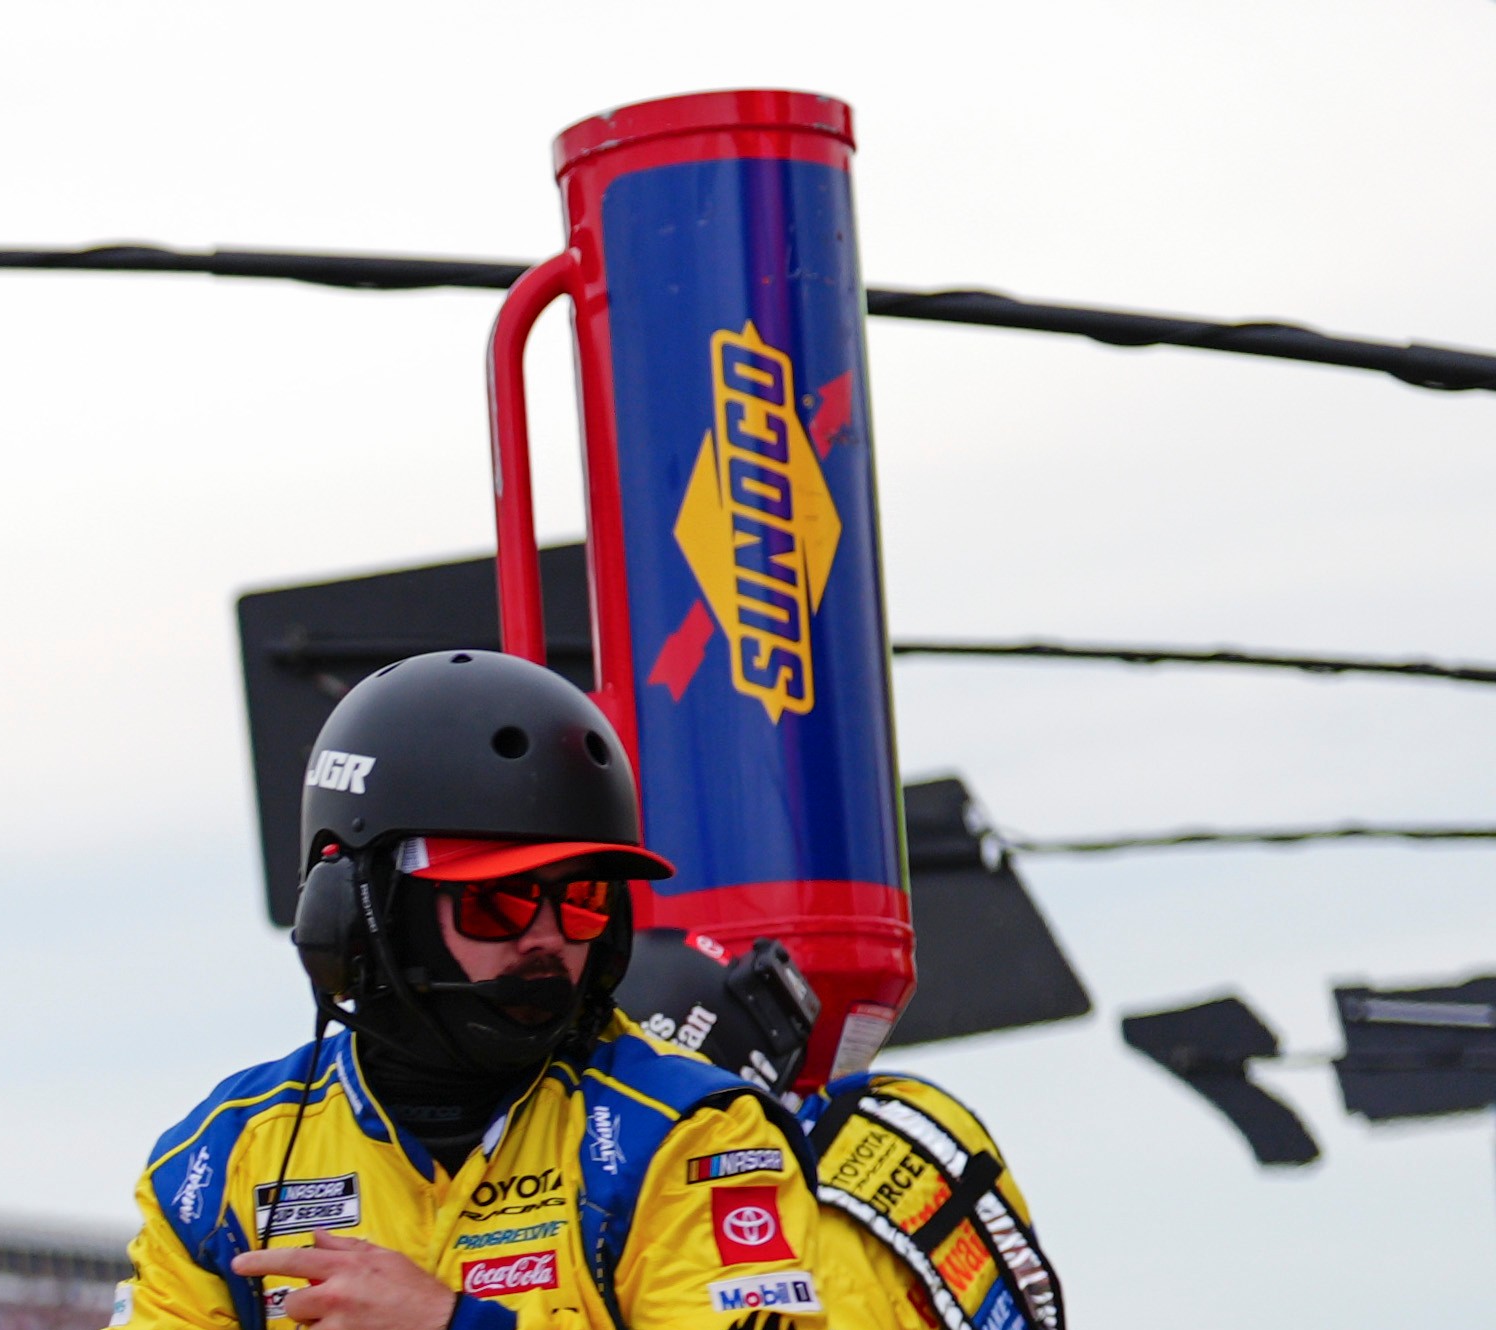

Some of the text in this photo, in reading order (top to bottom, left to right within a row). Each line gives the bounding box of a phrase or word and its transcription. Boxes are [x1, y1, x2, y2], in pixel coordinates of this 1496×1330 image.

[722, 342, 803, 701] SUNOCO
[306, 750, 376, 794] JGR
[592, 1105, 620, 1174] IMPACT
[719, 1150, 783, 1176] NASCAR
[284, 1181, 346, 1201] NASCAR
[459, 1197, 566, 1222] RACING
[453, 1220, 568, 1249] PROGRESSIVE
[465, 1251, 556, 1293] Coca-Cola
[719, 1282, 788, 1311] Mobil
